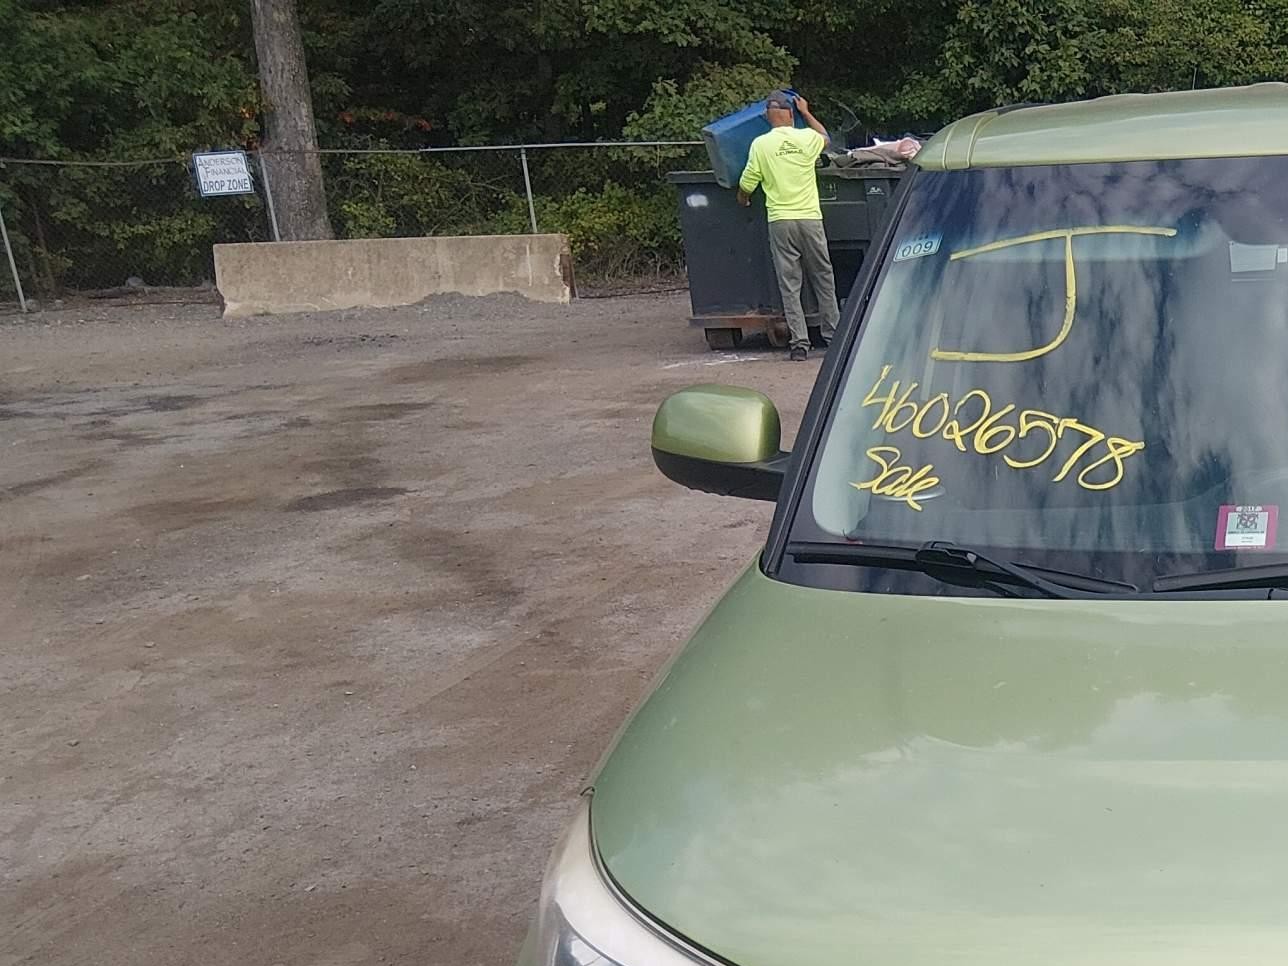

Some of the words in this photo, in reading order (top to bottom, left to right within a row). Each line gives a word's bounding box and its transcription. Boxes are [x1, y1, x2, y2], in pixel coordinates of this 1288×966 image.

[198, 157, 244, 167] ANDERSON
[203, 180, 226, 192] DROP
[227, 178, 249, 190] ZONE
[861, 364, 1145, 490] 46026578
